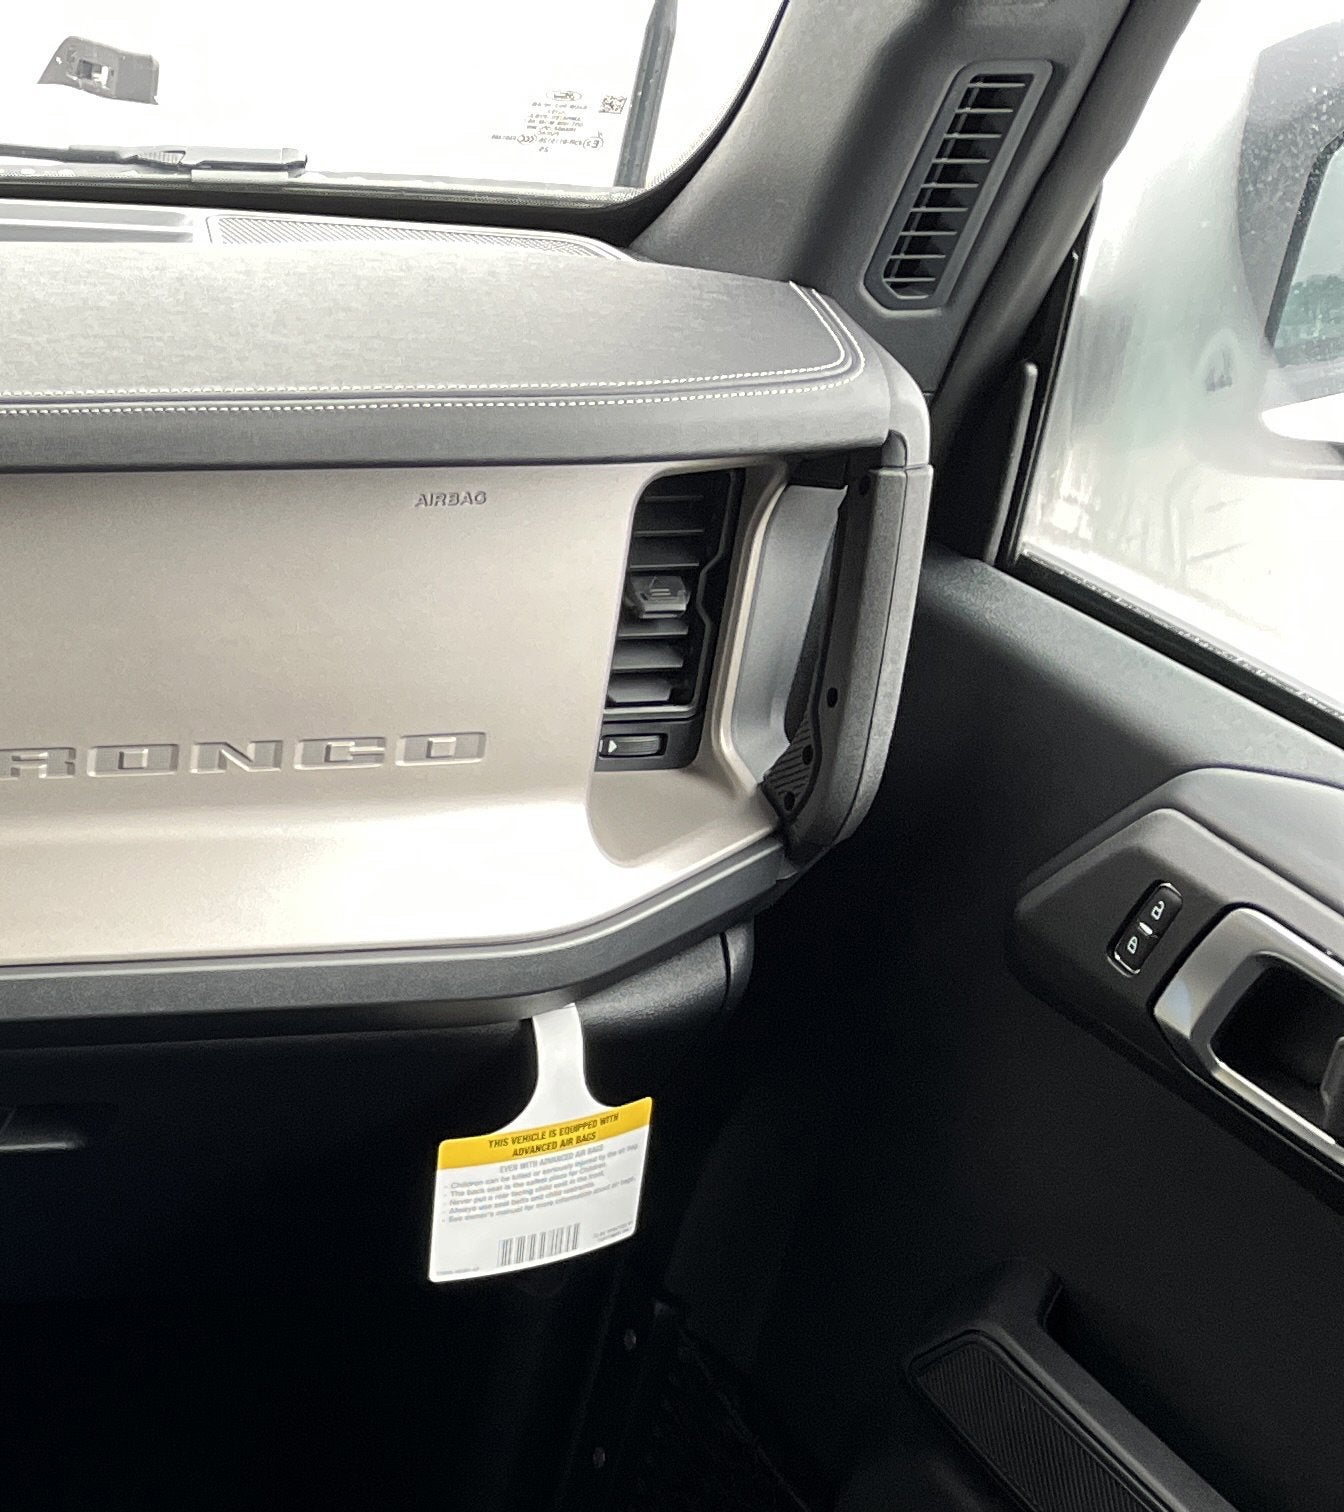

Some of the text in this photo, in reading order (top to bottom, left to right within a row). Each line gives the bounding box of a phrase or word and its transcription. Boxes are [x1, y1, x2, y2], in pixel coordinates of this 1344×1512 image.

[414, 490, 487, 508] AIRBAG
[488, 1113, 619, 1149] THIS VEHICLE IS EQUIPPED WITH
[512, 1131, 597, 1157] ADVANCED AIR BAGS
